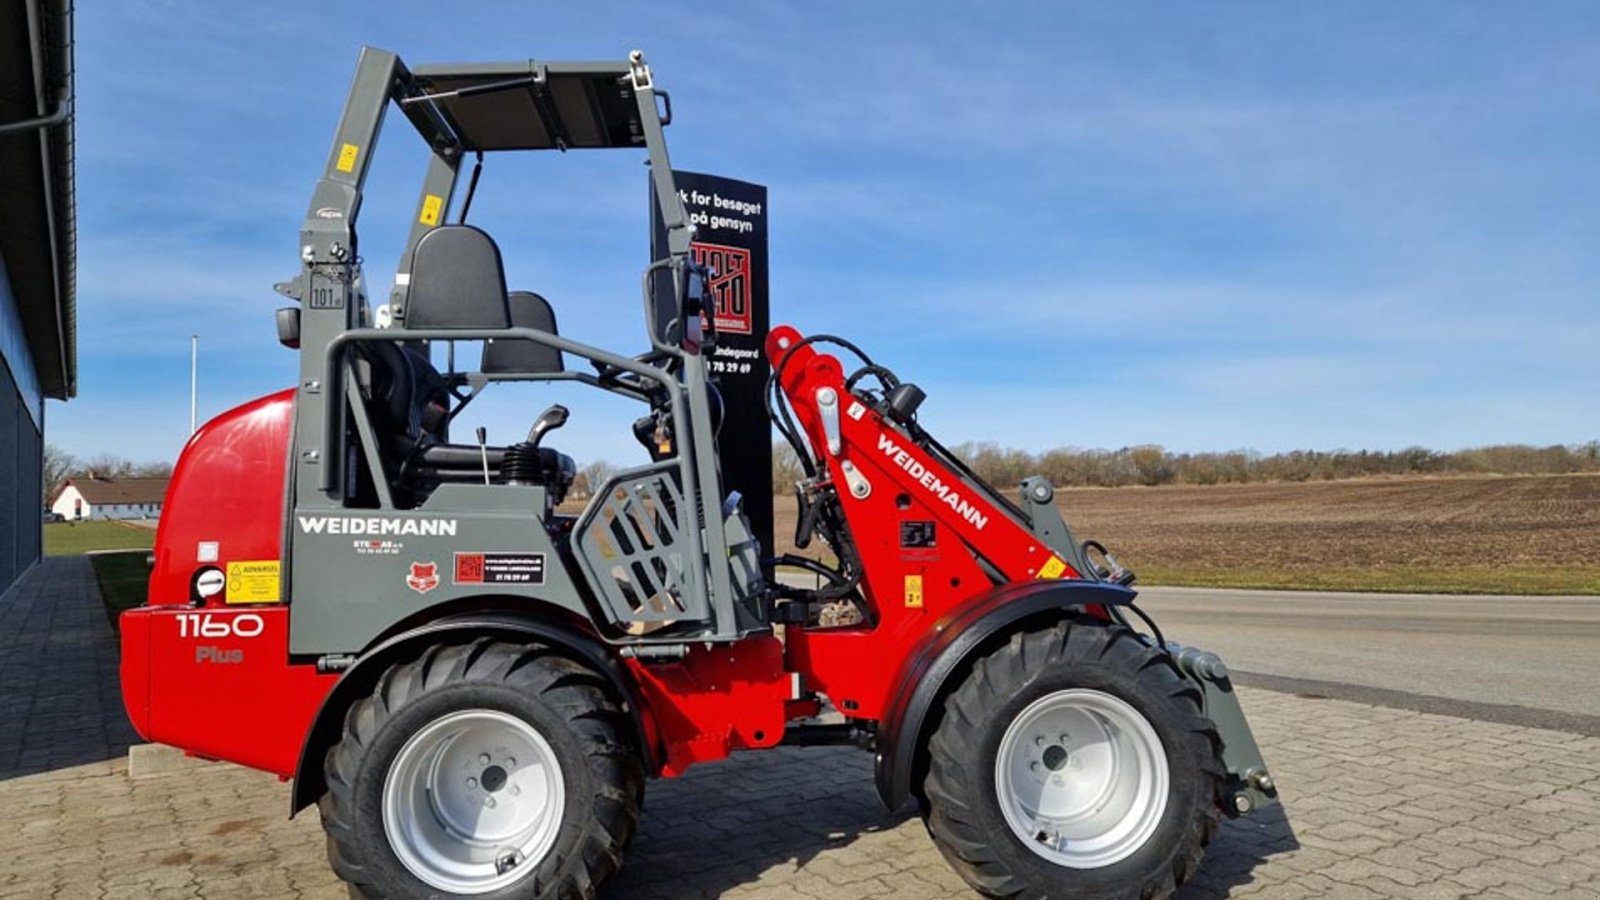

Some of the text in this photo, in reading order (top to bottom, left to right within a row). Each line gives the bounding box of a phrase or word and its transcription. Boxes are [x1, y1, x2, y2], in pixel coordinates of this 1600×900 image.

[691, 190, 712, 206] for
[714, 193, 762, 215] besøget
[690, 210, 753, 233] på gensyn
[313, 288, 333, 306] 101
[714, 345, 759, 359] indegaard
[712, 361, 725, 373] 78
[726, 362, 739, 373] 29
[739, 363, 751, 374] 69
[877, 433, 989, 530] WEIDEMANN
[298, 516, 457, 535] WEIDEMANN
[176, 614, 264, 637] 1160
[195, 646, 243, 663] Plus
